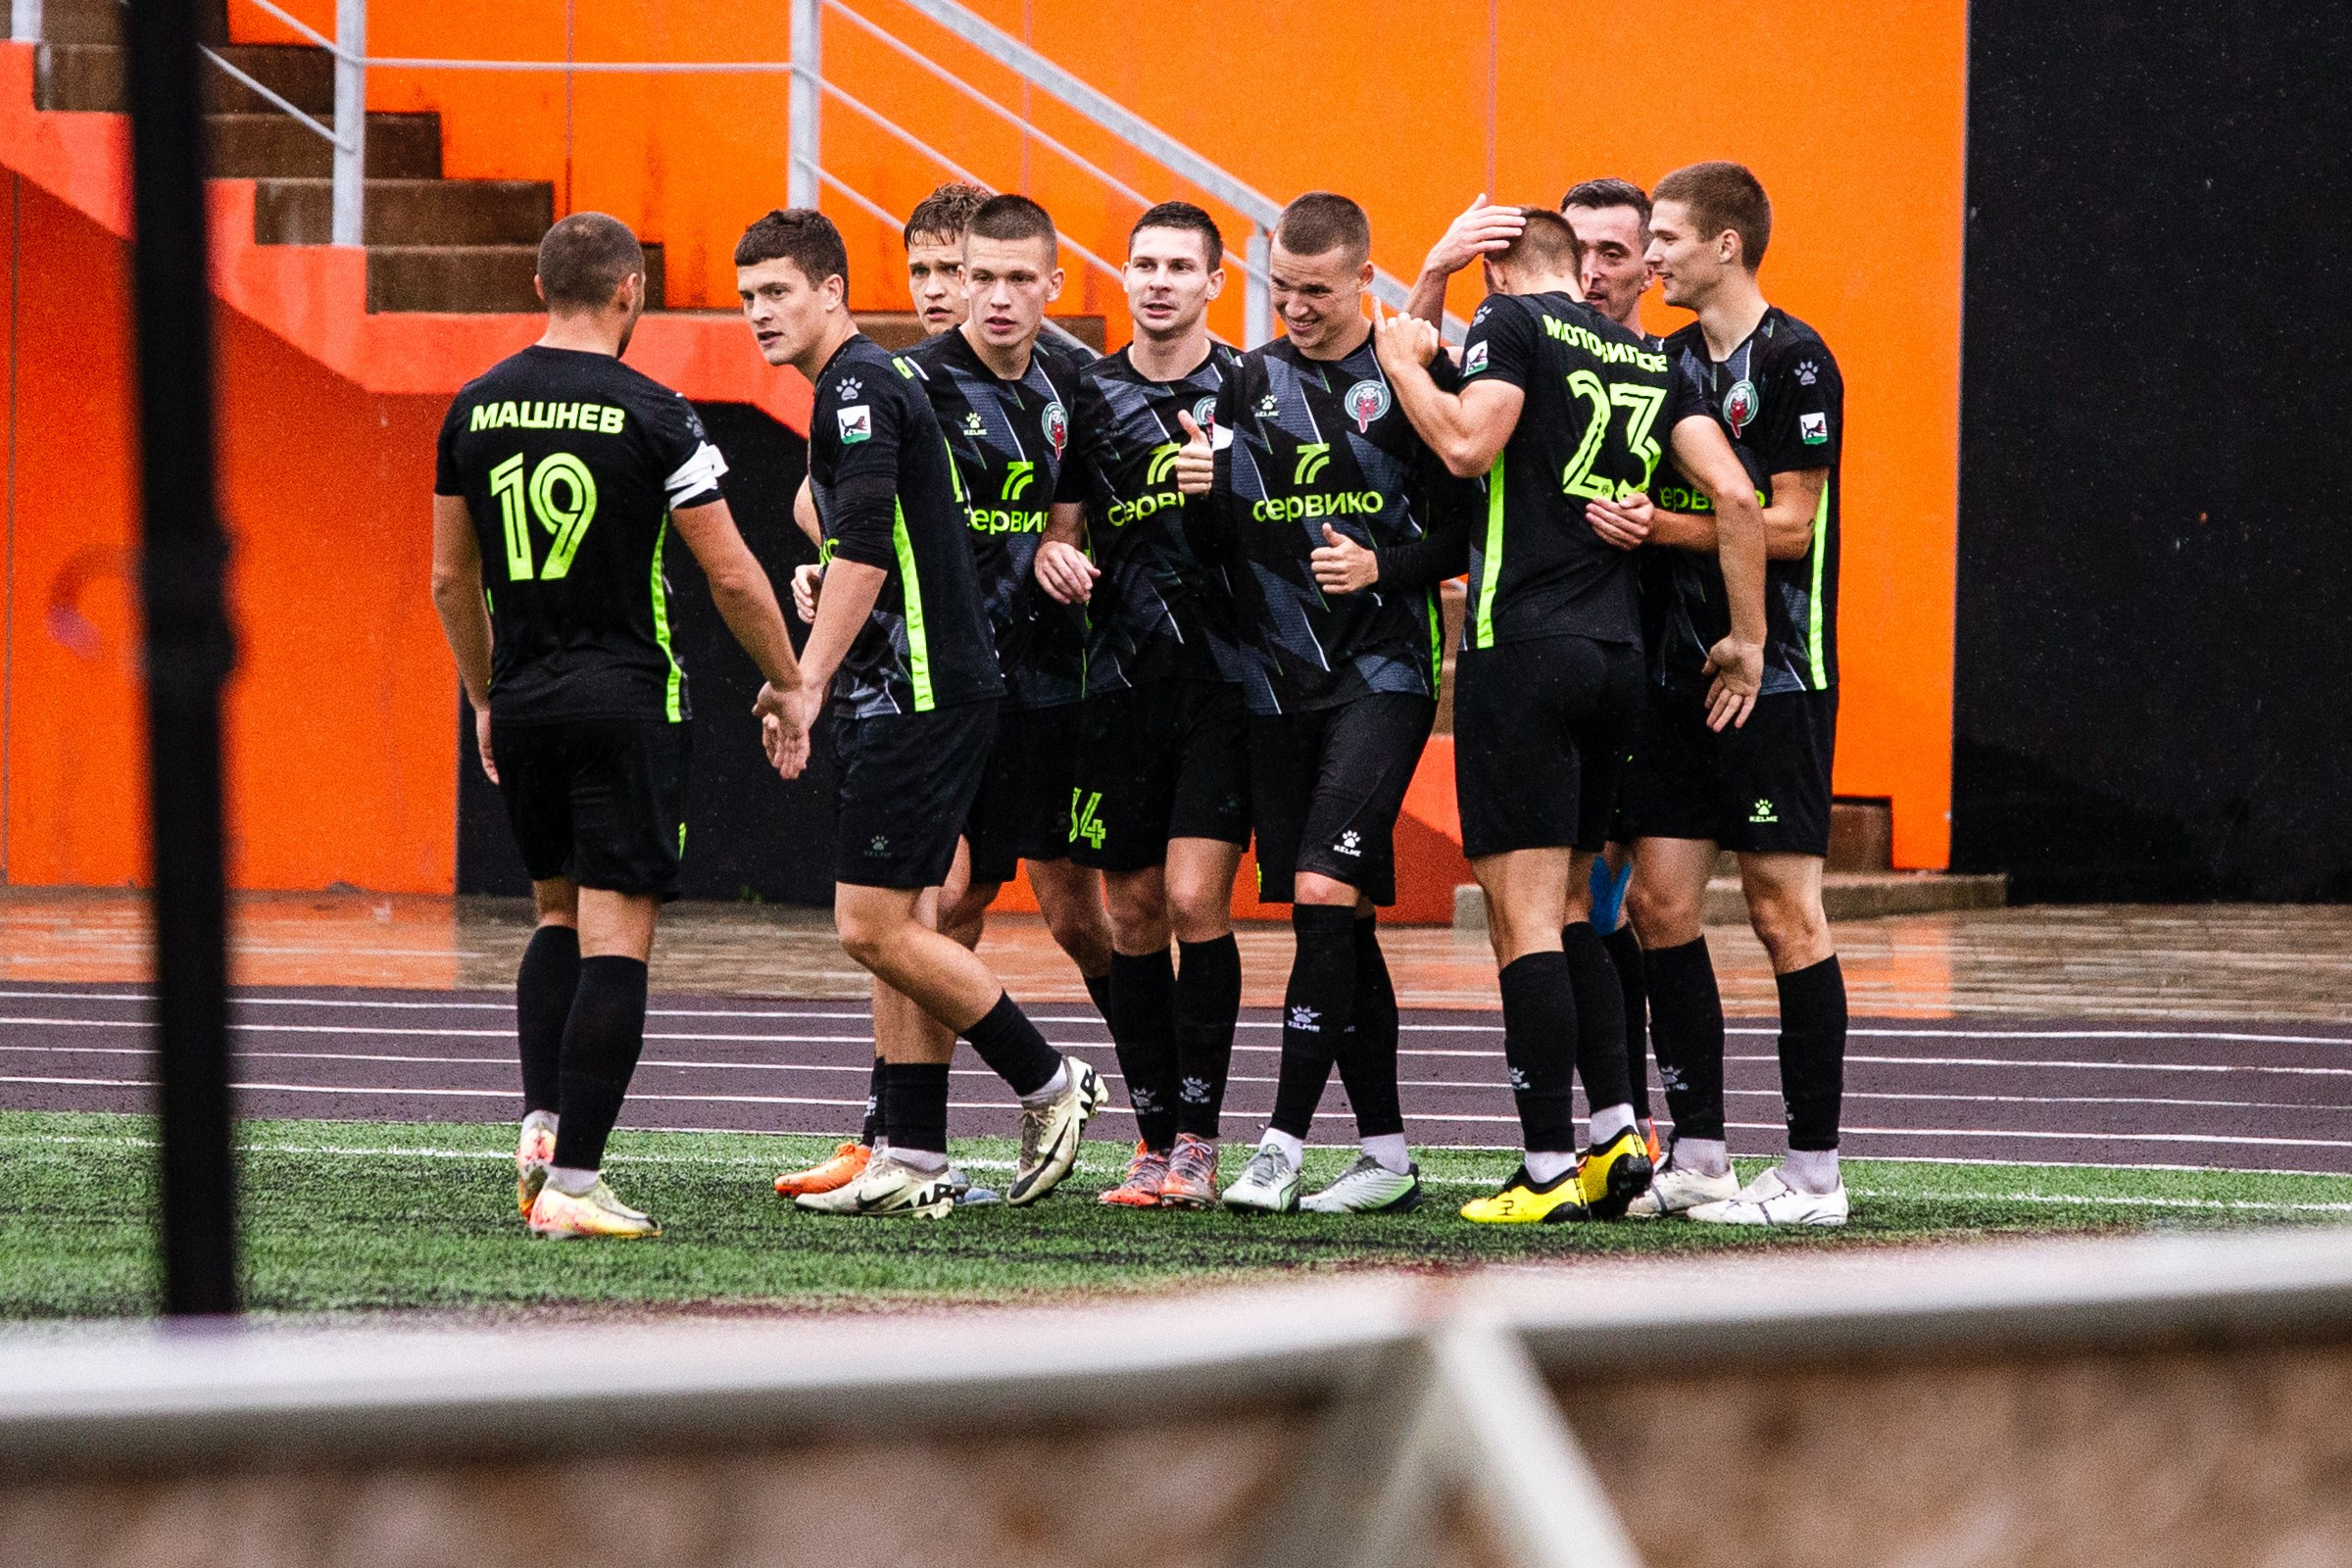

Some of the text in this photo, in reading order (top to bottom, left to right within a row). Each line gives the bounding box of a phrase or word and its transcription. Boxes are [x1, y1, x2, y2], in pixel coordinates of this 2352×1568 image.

[469, 400, 625, 434] МАШНЕВ
[1563, 369, 1667, 502] 23
[489, 451, 598, 582] 19
[1252, 491, 1384, 522] сервико
